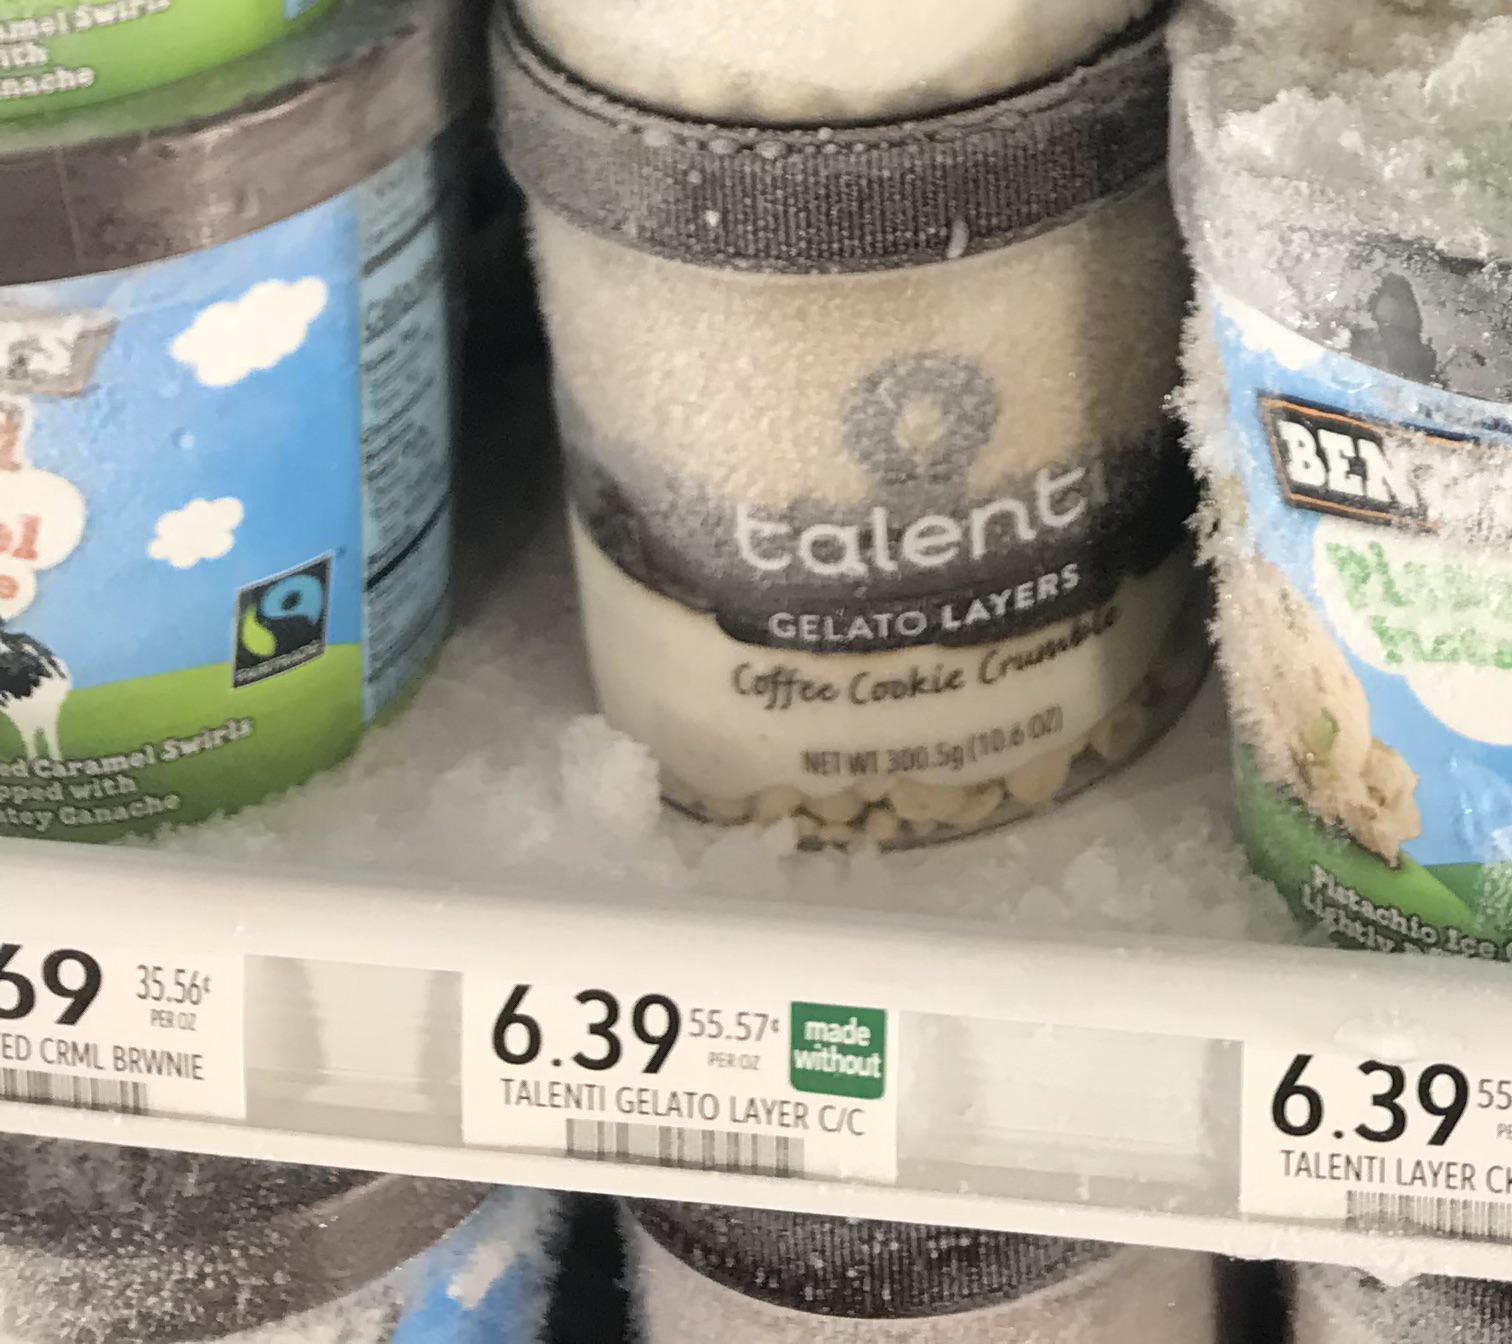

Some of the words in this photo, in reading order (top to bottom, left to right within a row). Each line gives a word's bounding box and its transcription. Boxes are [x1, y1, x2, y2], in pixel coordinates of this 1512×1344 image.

[768, 610, 928, 642] GELATO
[941, 562, 1081, 631] LAYERS
[732, 661, 839, 710] Coffee
[848, 663, 966, 706] Cookie
[33, 744, 156, 779] Caramel
[803, 749, 841, 776] NET
[848, 750, 879, 776] WT
[1312, 862, 1438, 945] Pistachio
[1446, 926, 1497, 961] Ice
[492, 984, 682, 1074] 6.39
[804, 1018, 871, 1047] made
[40, 1038, 105, 1070] CRML
[113, 1045, 206, 1081] BRWNIE
[708, 1052, 732, 1069] PER
[794, 1044, 881, 1079] without
[501, 1078, 606, 1112] TALENTI
[616, 1087, 720, 1121] GELATO
[730, 1096, 809, 1130] LAYER
[819, 1104, 867, 1137] C/C
[1271, 1053, 1470, 1147] 6.39
[1280, 1149, 1386, 1184] TALENTI
[1396, 1158, 1476, 1193] LAYER
